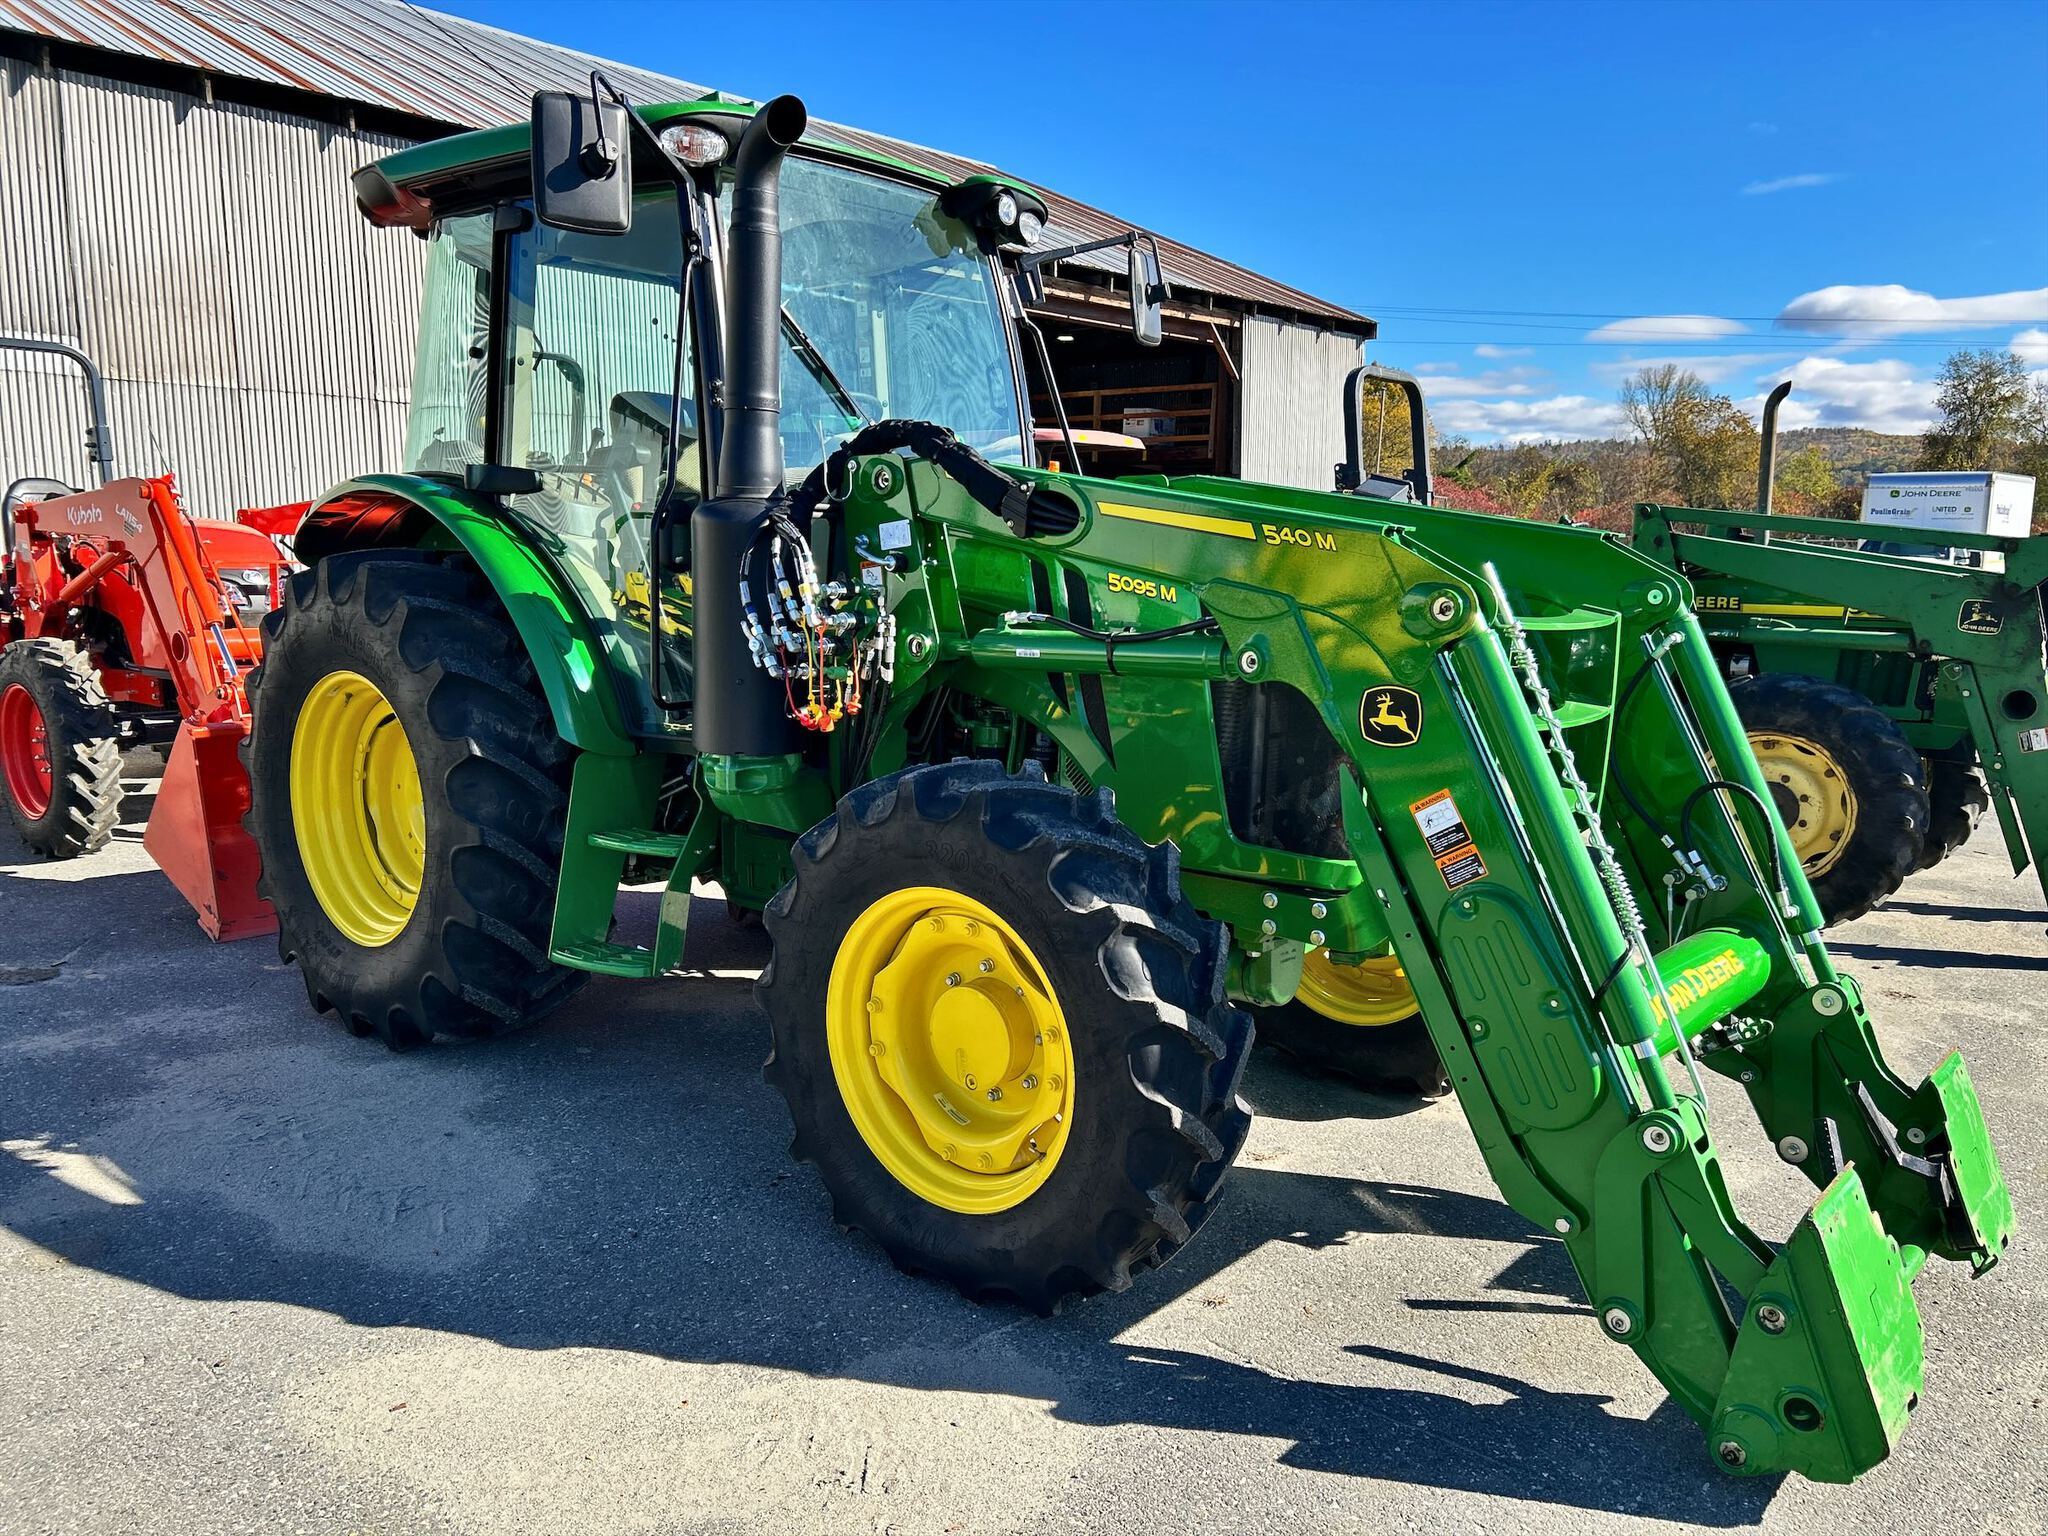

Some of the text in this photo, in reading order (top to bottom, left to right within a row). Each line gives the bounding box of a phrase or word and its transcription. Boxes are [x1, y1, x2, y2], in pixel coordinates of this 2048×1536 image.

[1902, 489, 1928, 498] JOHN
[1929, 489, 1962, 497] DEERE
[67, 503, 103, 526] Kubota
[1261, 523, 1338, 552] 540 M
[1107, 572, 1178, 603] 5095 M
[1695, 596, 1740, 609] EERE
[1420, 792, 1446, 808] WARNING
[1447, 848, 1474, 863] WARNING
[1682, 948, 1746, 998] DEERE
